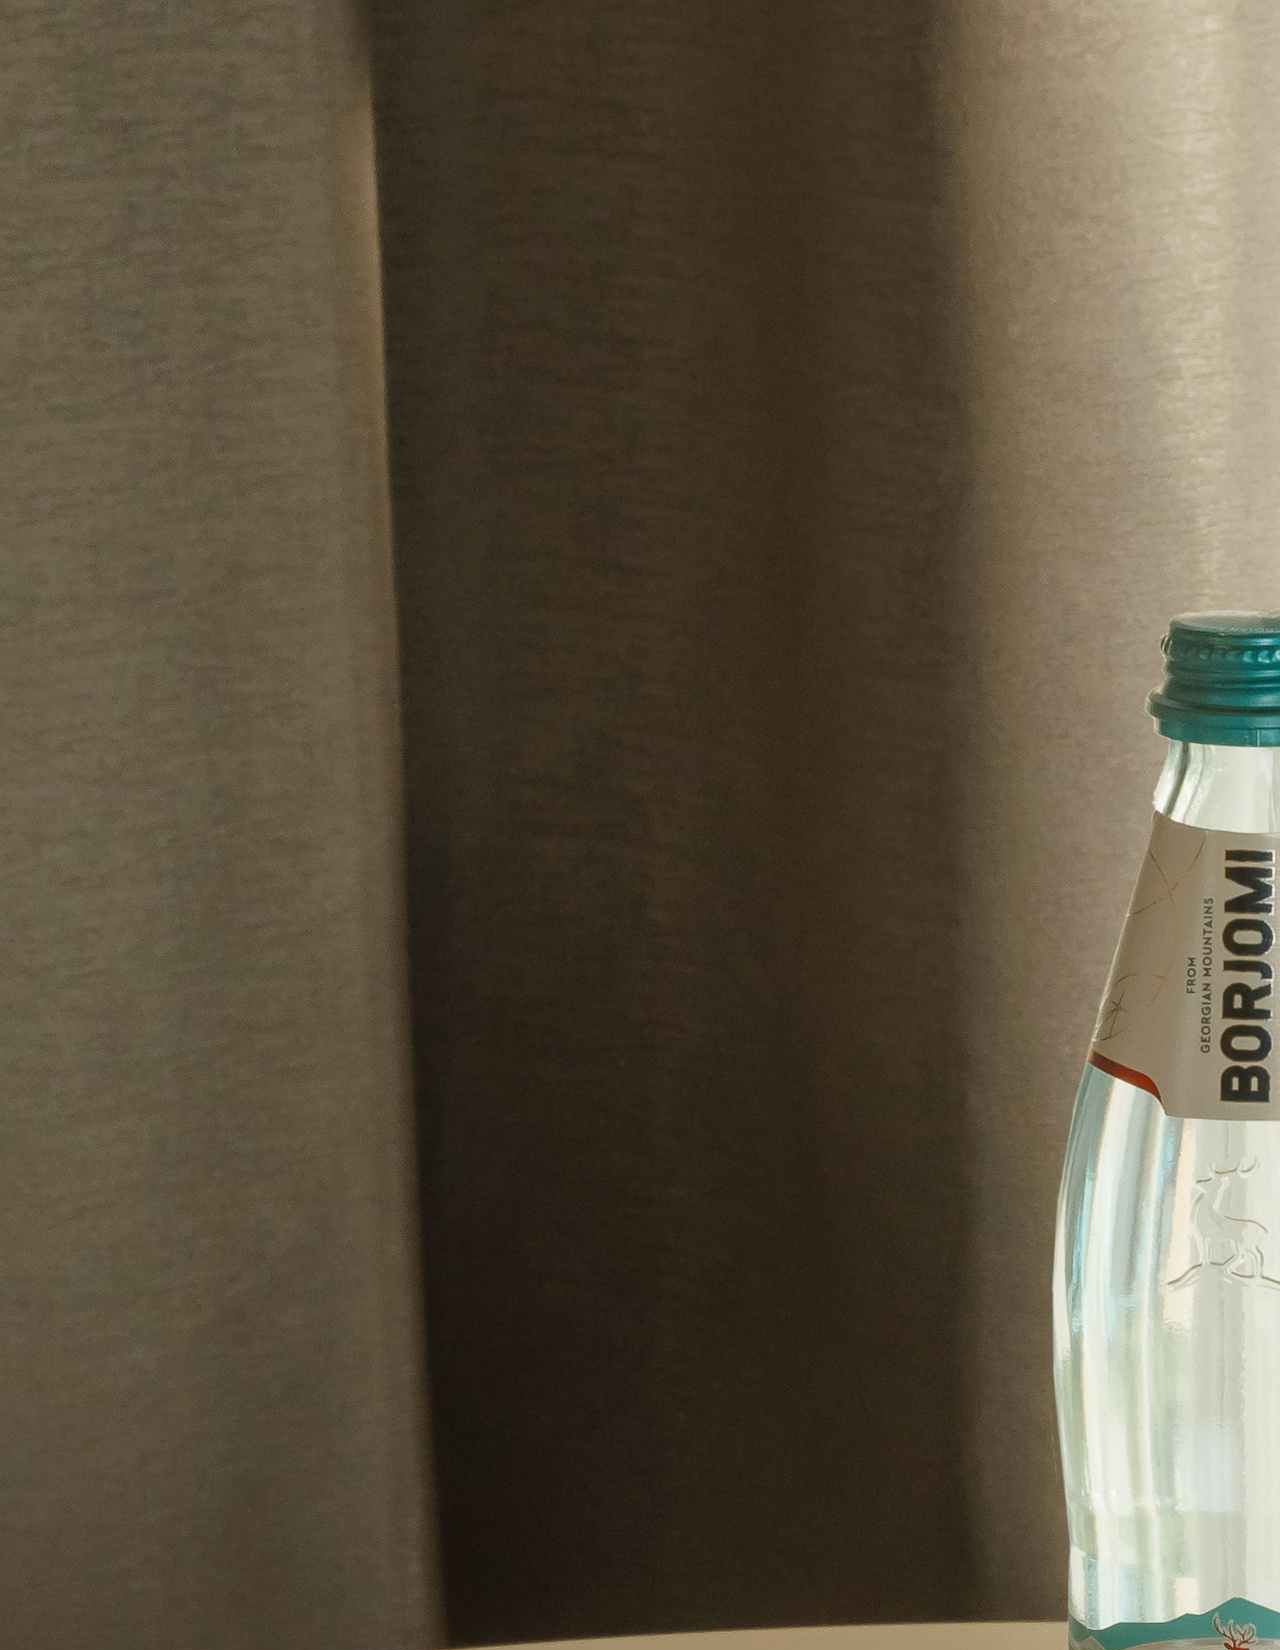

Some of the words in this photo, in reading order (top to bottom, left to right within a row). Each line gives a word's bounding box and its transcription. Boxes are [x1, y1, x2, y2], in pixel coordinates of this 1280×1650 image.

[1186, 956, 1197, 994] FROM
[1203, 897, 1214, 978] MOUNTAINS
[1220, 850, 1275, 1103] BORJOMI
[1200, 982, 1212, 1054] GEORGIAN
